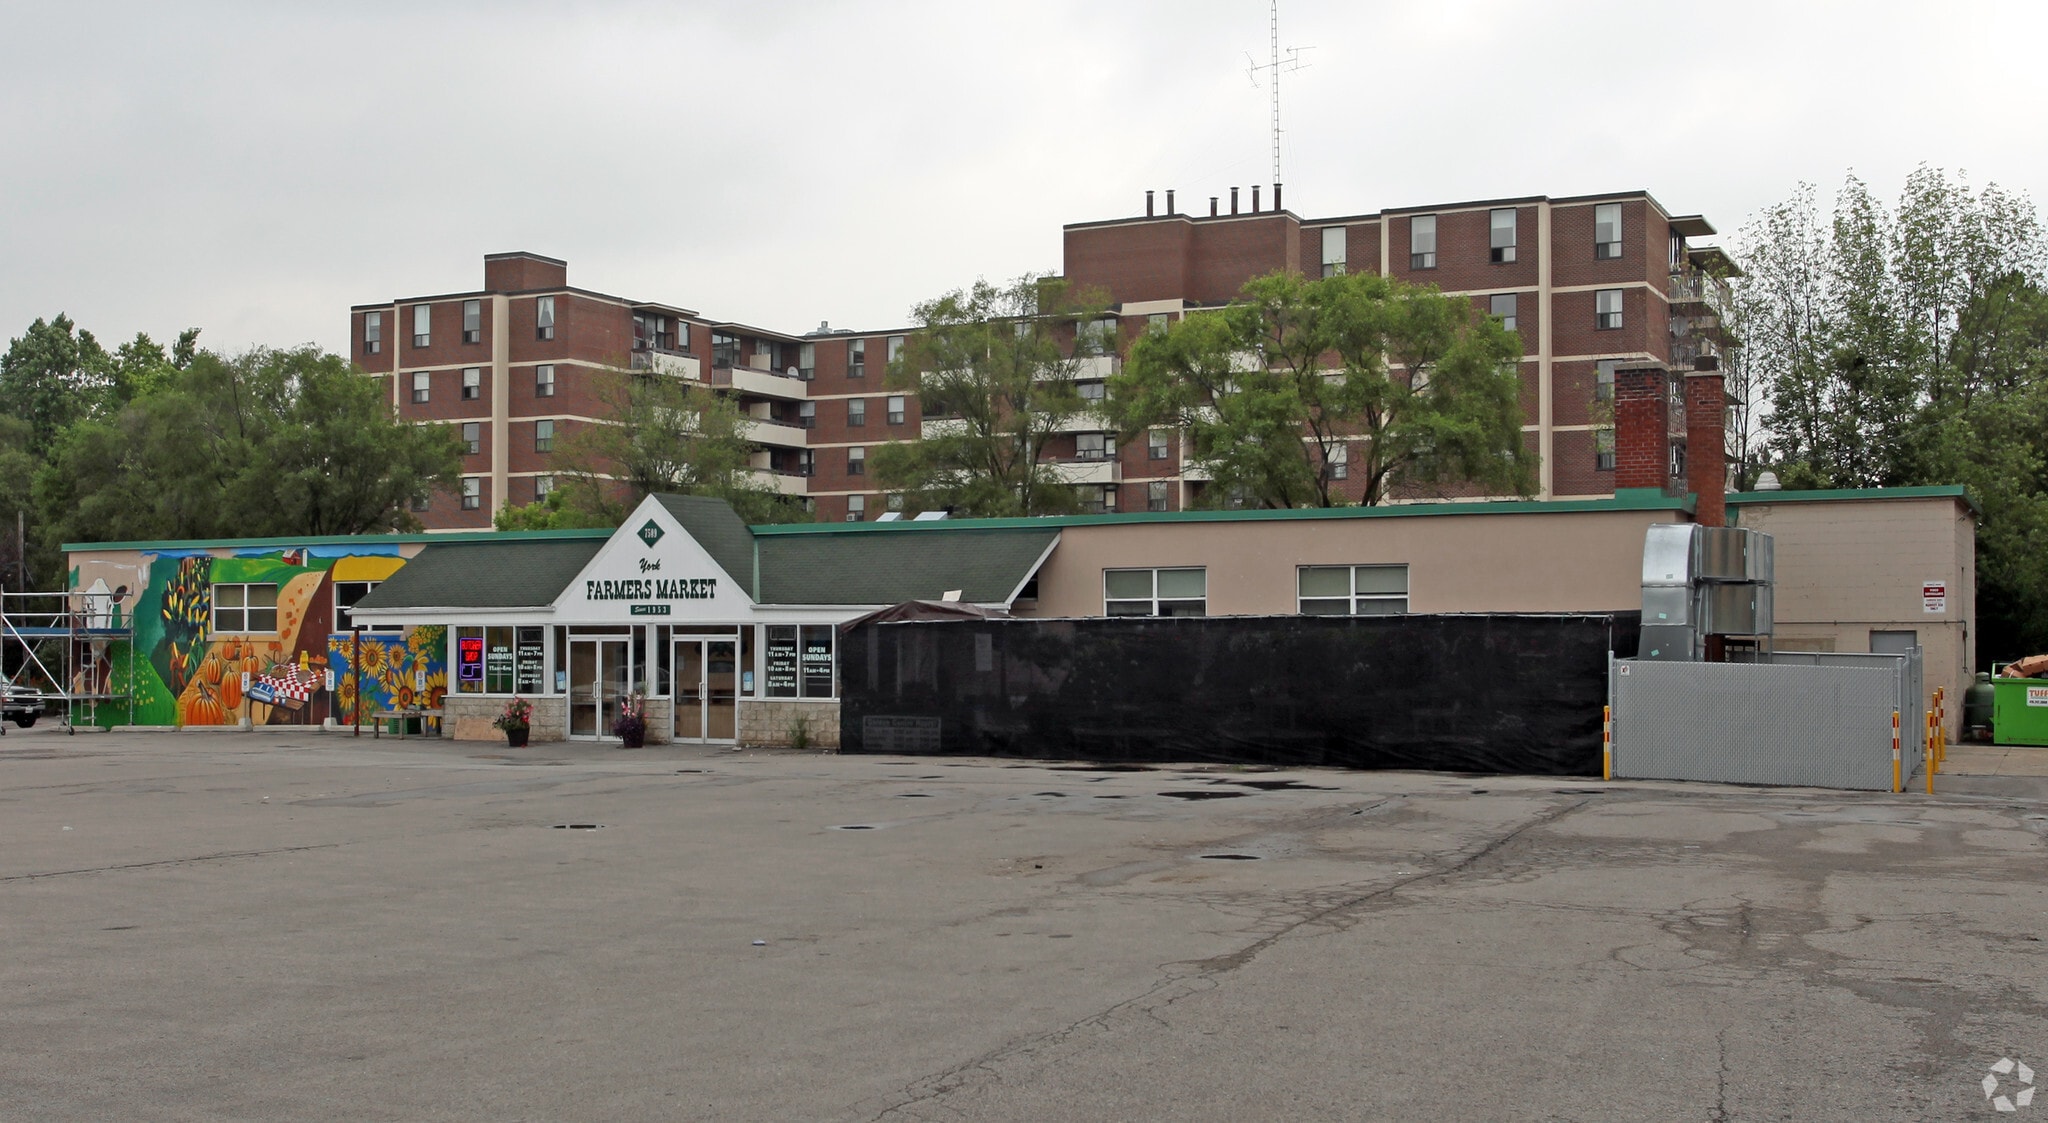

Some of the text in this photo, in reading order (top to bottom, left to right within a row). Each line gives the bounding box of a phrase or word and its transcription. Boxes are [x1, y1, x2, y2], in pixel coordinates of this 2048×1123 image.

[638, 558, 661, 574] York
[586, 578, 717, 600] FARMERS MARKET
[802, 653, 832, 661] SUNDAYS
